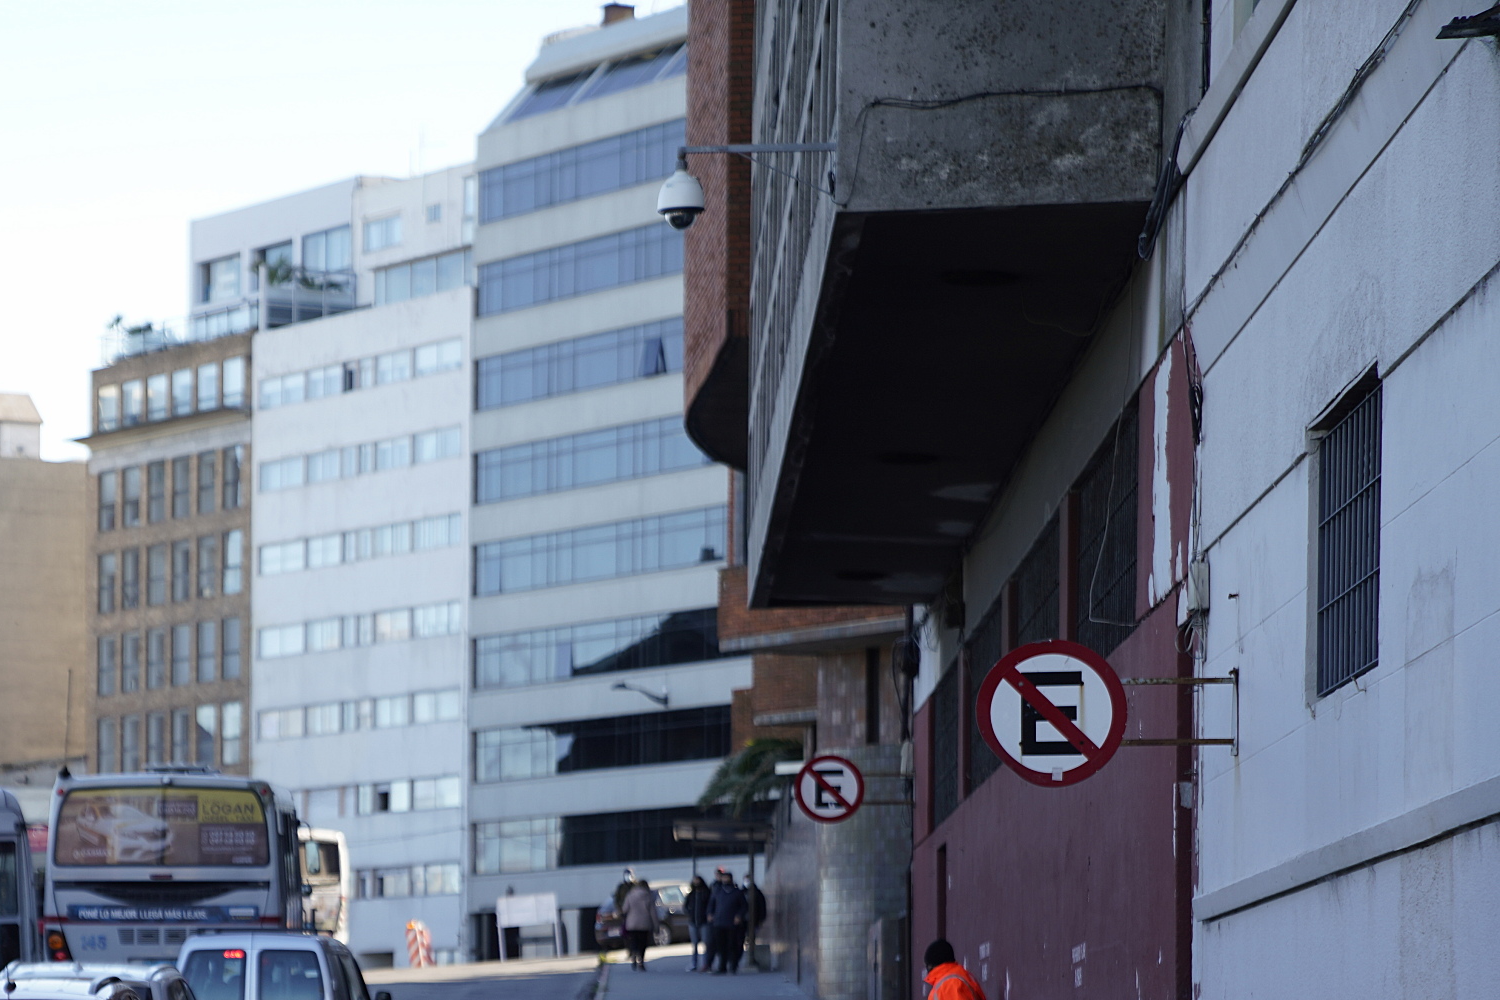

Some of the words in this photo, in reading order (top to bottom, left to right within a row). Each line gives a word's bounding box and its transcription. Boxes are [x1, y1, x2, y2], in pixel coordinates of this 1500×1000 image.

[1021, 671, 1083, 755] E
[814, 769, 845, 809] E
[202, 803, 255, 816] LOGAN
